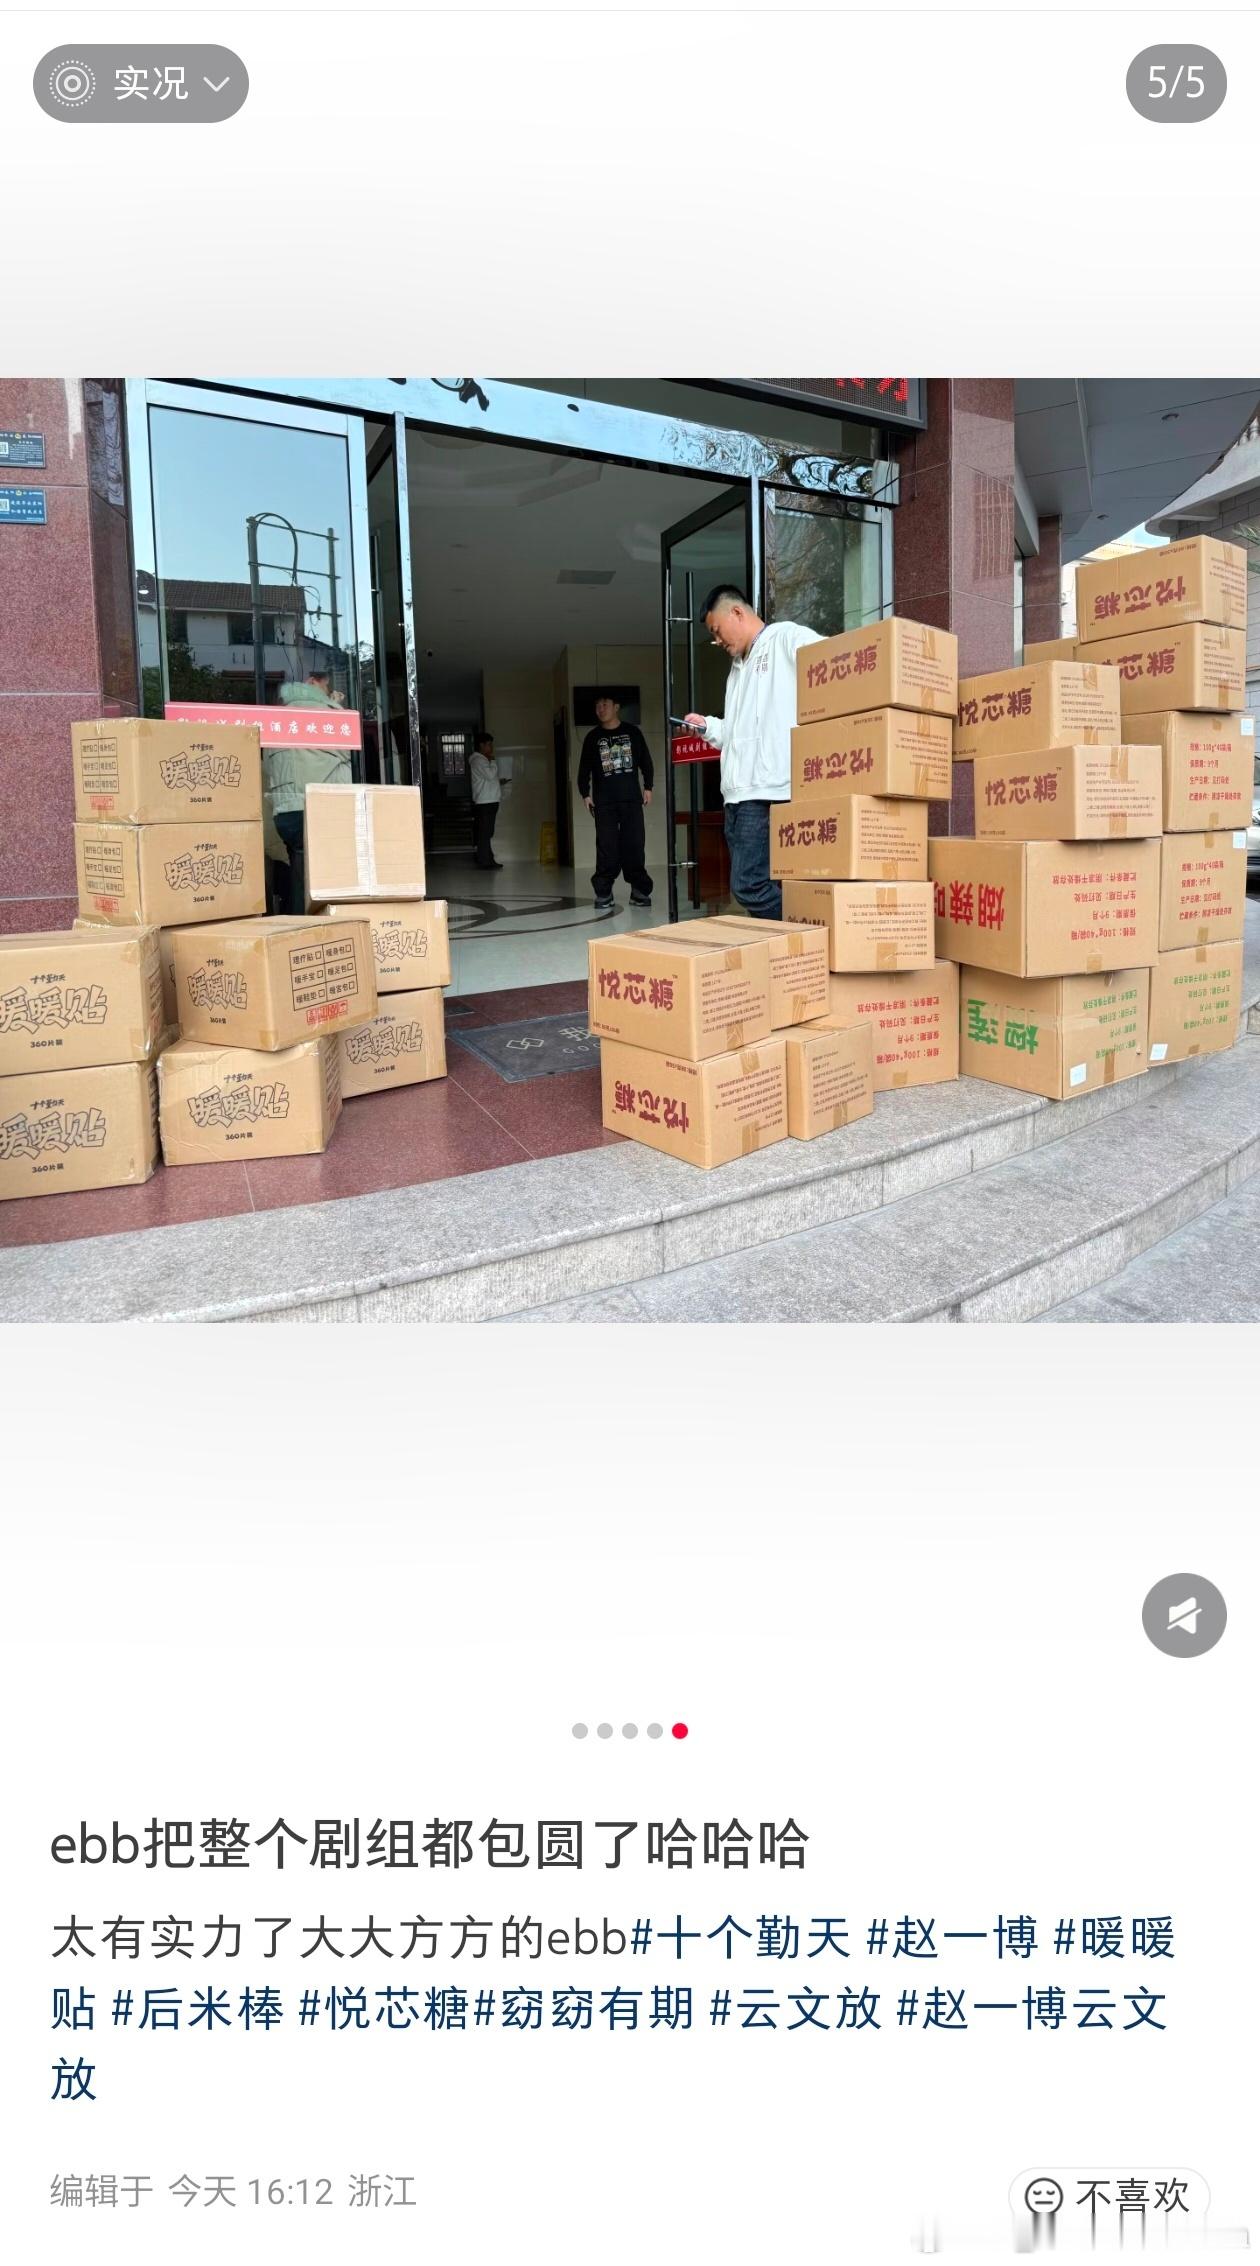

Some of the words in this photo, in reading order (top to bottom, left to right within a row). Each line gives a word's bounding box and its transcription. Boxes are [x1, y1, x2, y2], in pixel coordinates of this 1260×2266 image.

[1095, 576, 1186, 620] 悦芯糖
[806, 644, 878, 689] 悦芯糖
[1102, 648, 1176, 681] 芯糖
[957, 687, 1033, 727] 悦芯糖
[159, 751, 241, 792] 暖暖贴
[803, 747, 874, 783] 悦芯糖
[984, 772, 1058, 806] 悦芯糖
[778, 816, 838, 849] 悦芯糖
[163, 852, 244, 892] 暖暖贴
[187, 967, 248, 1011] 暖暖贴
[598, 967, 675, 1012] 悦芯糖
[345, 1021, 423, 1065] 暖暖贴
[187, 1082, 290, 1128] 暖暖贴
[614, 1079, 690, 1134] 悦芯糖
